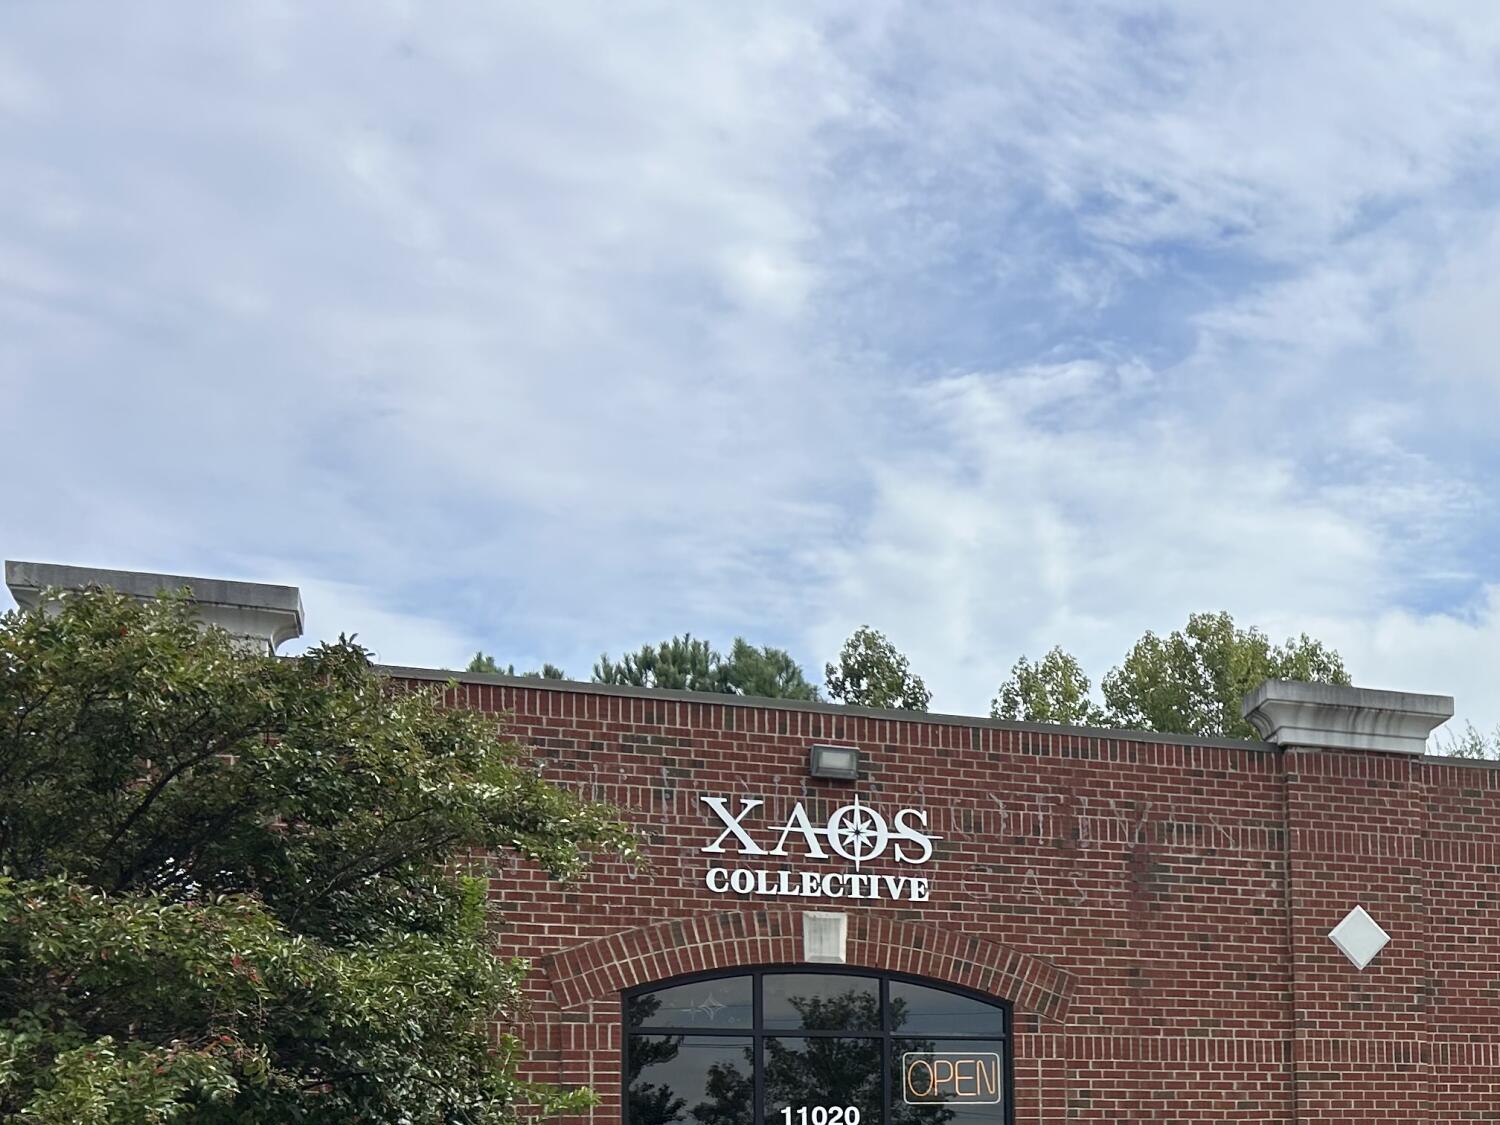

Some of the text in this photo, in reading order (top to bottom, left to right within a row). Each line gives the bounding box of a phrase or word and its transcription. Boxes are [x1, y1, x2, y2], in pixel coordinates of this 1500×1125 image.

[700, 795, 938, 867] XAOS
[705, 866, 929, 902] COLLECTIVE
[907, 1059, 996, 1098] OPEN
